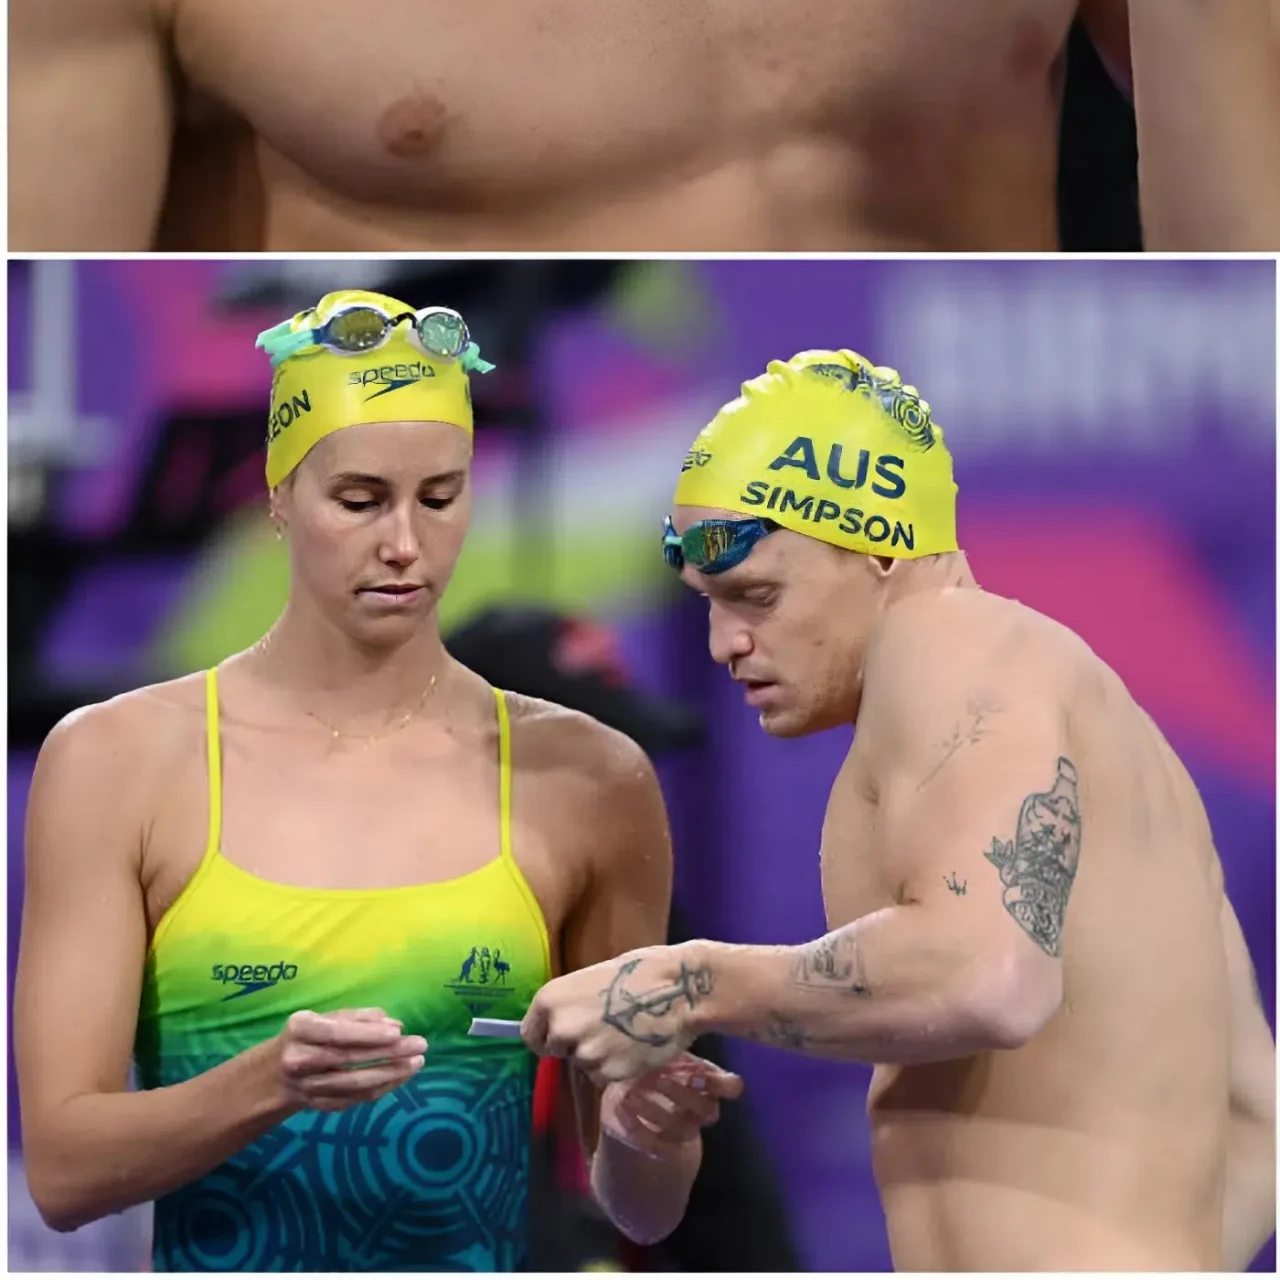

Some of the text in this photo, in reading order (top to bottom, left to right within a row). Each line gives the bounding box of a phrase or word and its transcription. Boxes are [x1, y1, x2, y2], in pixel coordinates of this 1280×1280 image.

[348, 361, 436, 387] speedo
[266, 388, 312, 443] EON
[767, 435, 907, 499] AUS
[739, 481, 915, 551] SIMPSON
[210, 960, 298, 985] speedo
